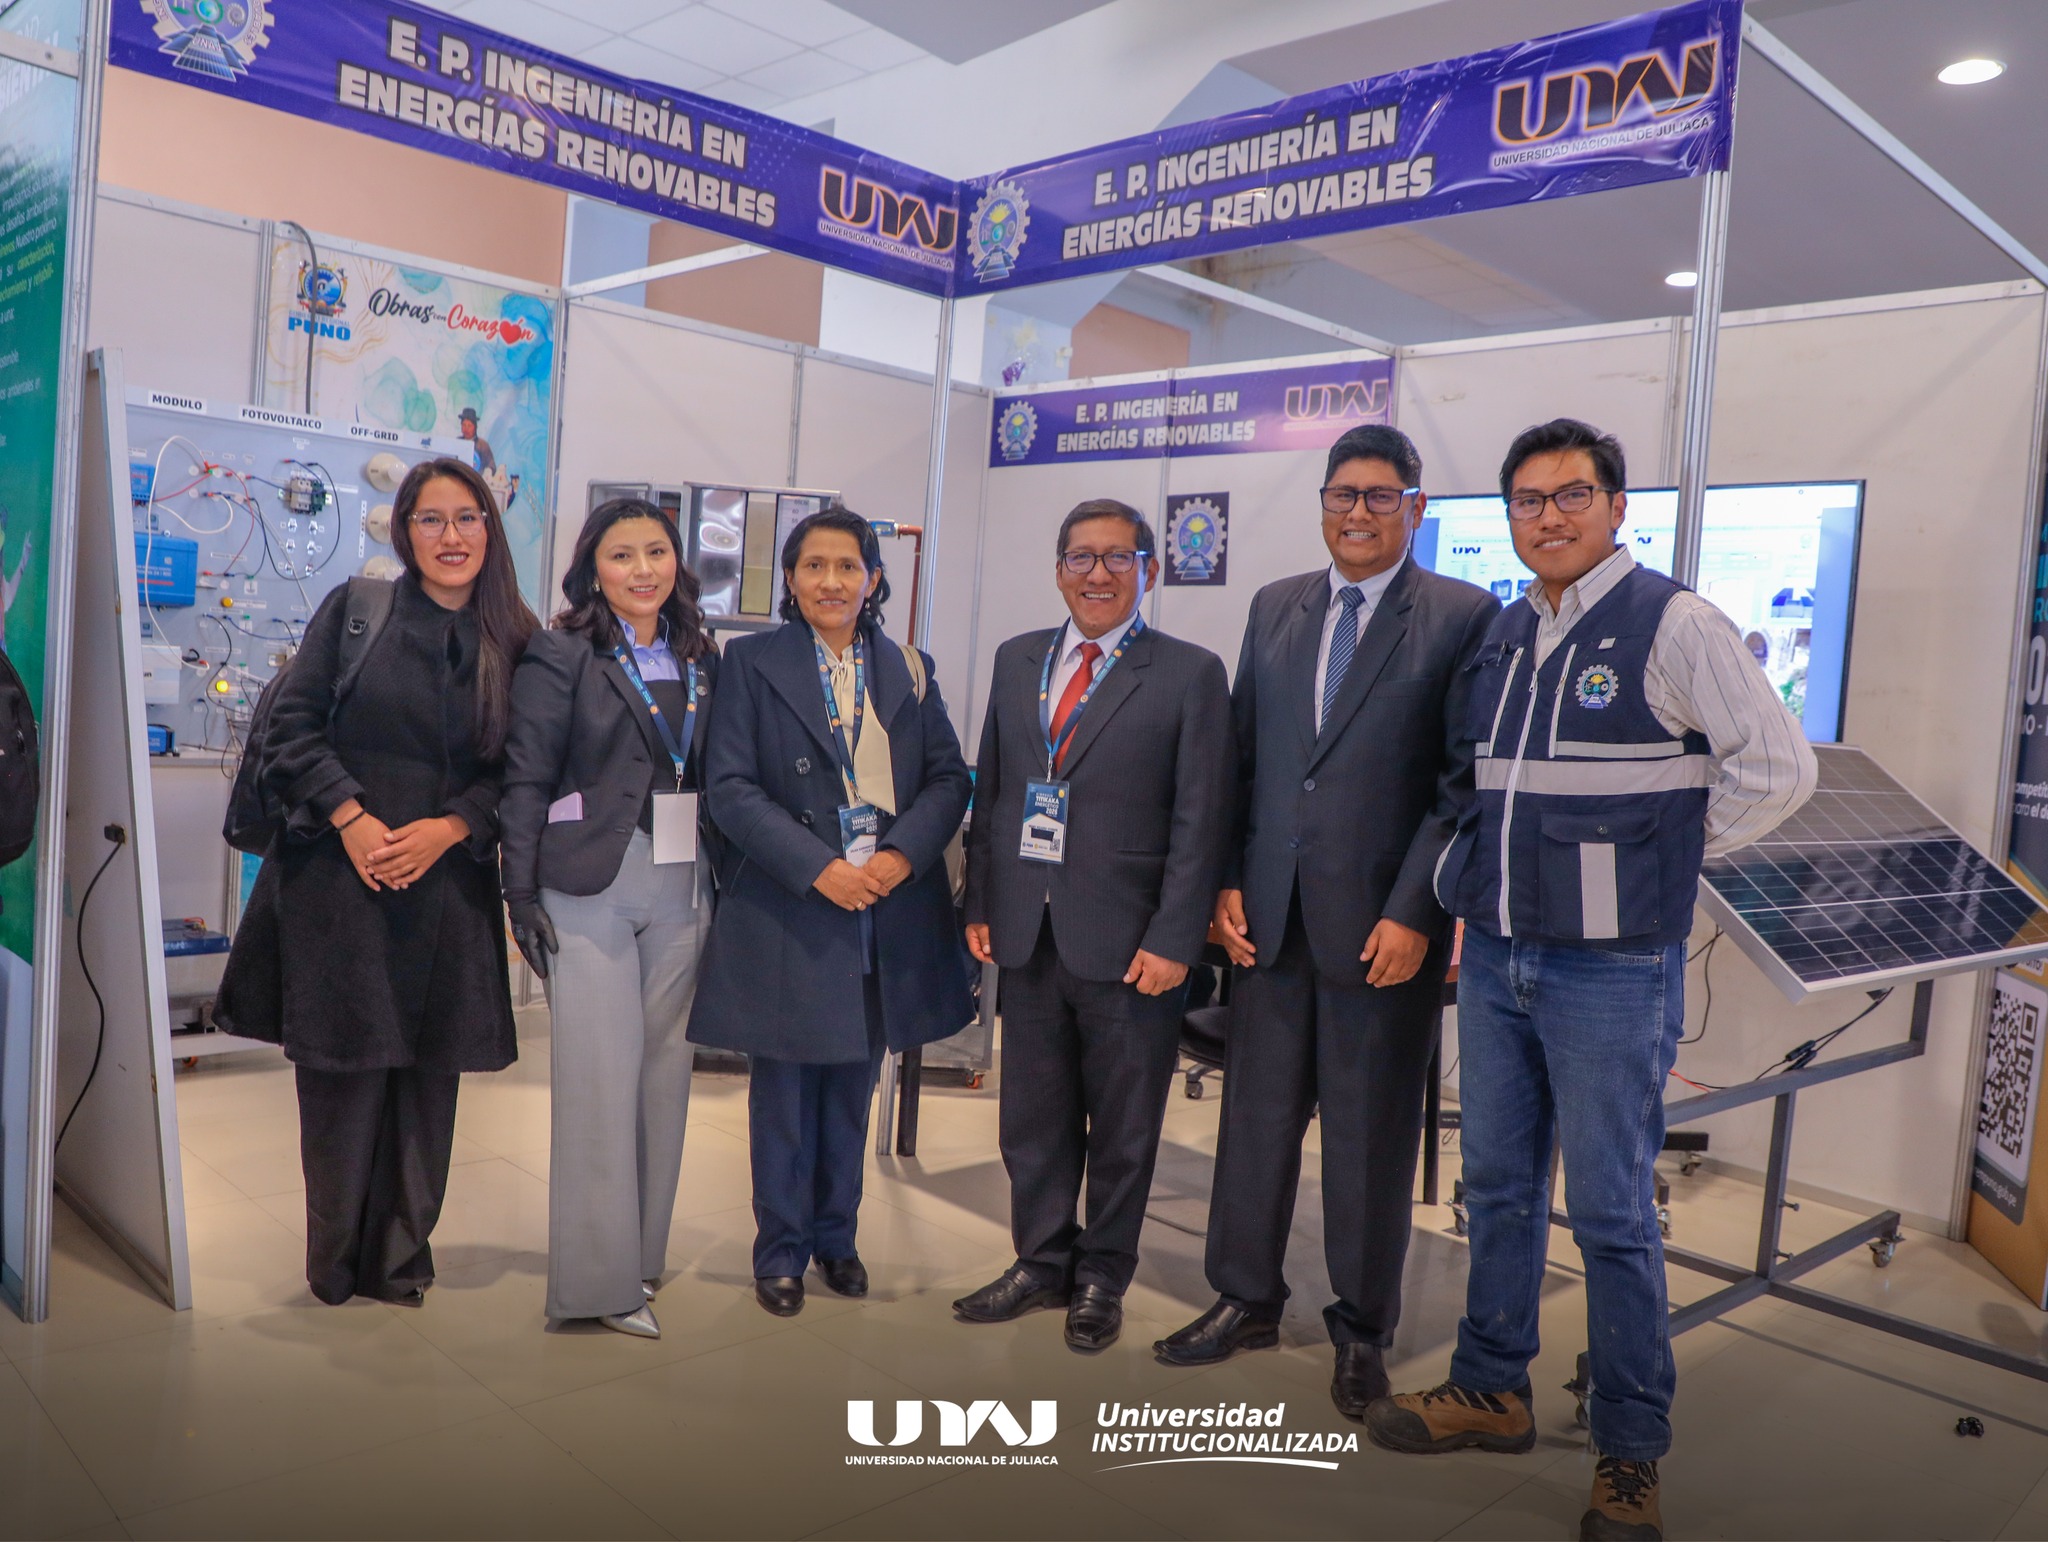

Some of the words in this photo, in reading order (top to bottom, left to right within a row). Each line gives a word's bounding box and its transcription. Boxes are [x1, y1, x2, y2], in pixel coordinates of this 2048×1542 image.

[389, 18, 427, 68] E.
[440, 35, 471, 82] P.
[485, 49, 692, 153] INGENIERÍA
[702, 122, 746, 169] EN
[339, 62, 546, 159] ENERGÍAS
[557, 129, 776, 228] RENOVABLES
[1094, 171, 1118, 206] E.
[1126, 164, 1148, 199] P.
[1157, 113, 1337, 192] INGENIERÍA
[1347, 105, 1398, 152] EN
[1493, 144, 1568, 167] UNIVERSIDAD
[1572, 131, 1633, 153] NACIONAL
[1636, 127, 1653, 141] DE
[1656, 116, 1709, 138] JULIACA
[1062, 200, 1202, 260] ENERGÍAS
[1210, 156, 1434, 232] RENOVABLES
[820, 222, 871, 244] UNIVERSIDAD
[872, 238, 910, 257] NACIONAL
[910, 250, 921, 260] DE
[922, 253, 952, 269] JULIACA
[368, 288, 434, 324] Obras
[288, 316, 351, 341] PUNO
[151, 394, 203, 411] MODULO
[241, 408, 323, 430] FOTOVOLTAICO
[1075, 404, 1090, 424] E.
[1094, 402, 1108, 422] P.
[1212, 391, 1239, 412] EN
[350, 425, 399, 442] OFF-GRID
[1056, 425, 1139, 452] ENERGÍAS
